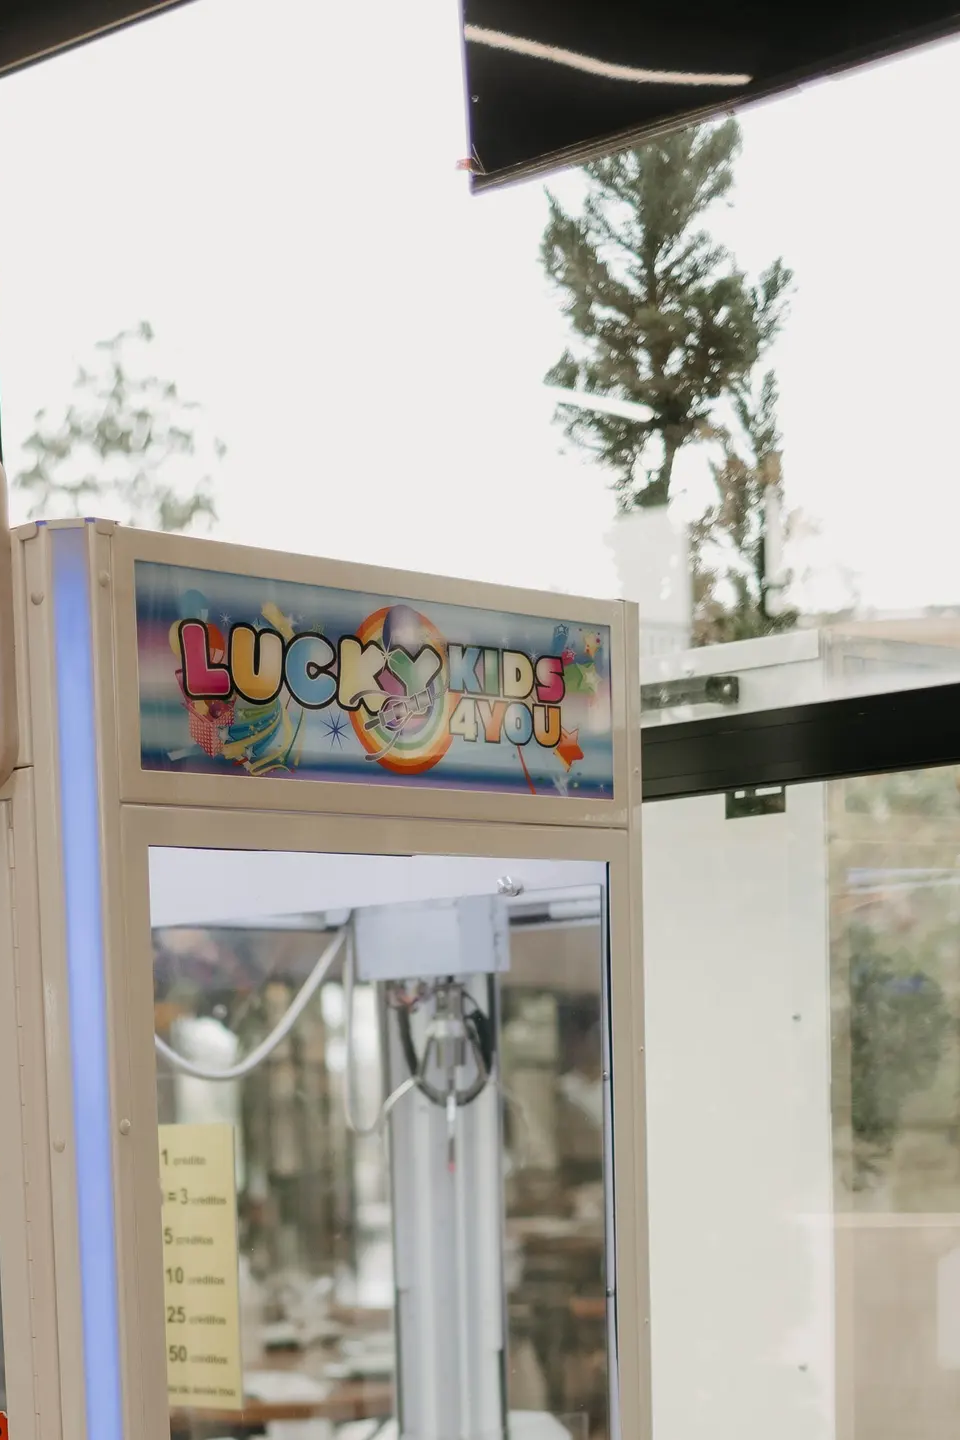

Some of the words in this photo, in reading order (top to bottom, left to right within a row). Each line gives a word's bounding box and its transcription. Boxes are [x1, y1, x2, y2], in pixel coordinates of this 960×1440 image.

[178, 617, 444, 710] LUCKY
[447, 642, 568, 704] KIDS
[449, 697, 563, 749] 4YOU
[164, 1226, 174, 1245] 5
[165, 1266, 184, 1285] 10
[167, 1306, 186, 1324] 25
[168, 1345, 188, 1363] 50
